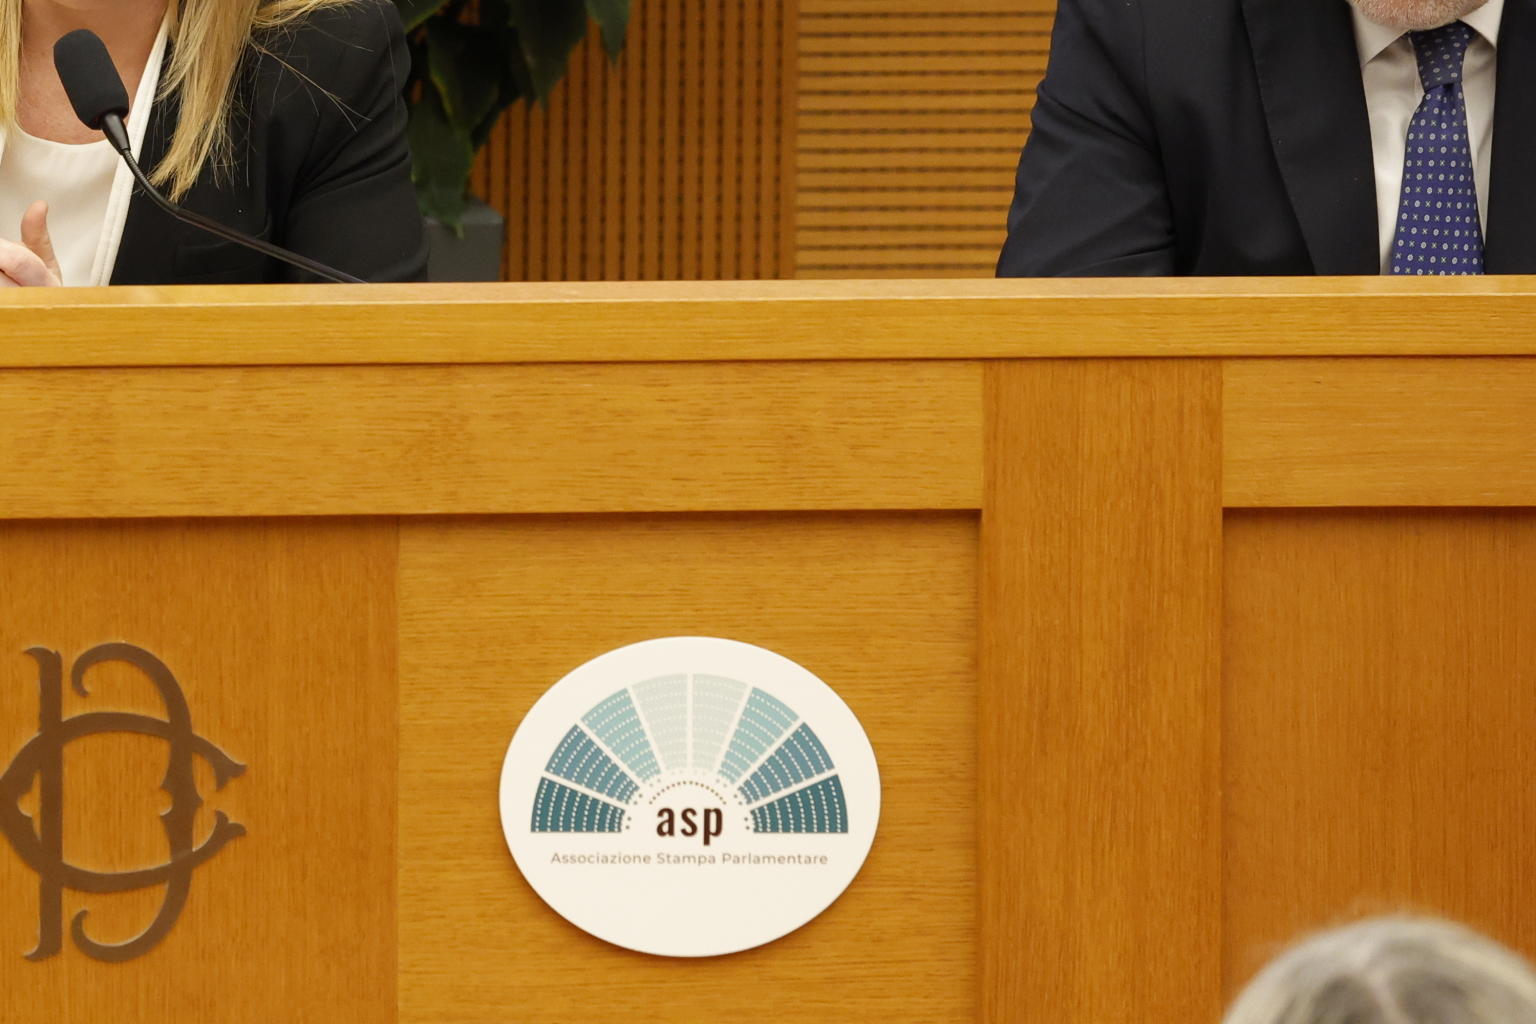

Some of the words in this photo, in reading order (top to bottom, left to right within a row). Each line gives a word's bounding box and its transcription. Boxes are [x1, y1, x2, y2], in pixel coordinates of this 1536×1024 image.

[656, 807, 723, 846] asp
[550, 852, 652, 865] Associazione
[656, 852, 716, 867] Stampa
[722, 852, 828, 865] Parlamentare
